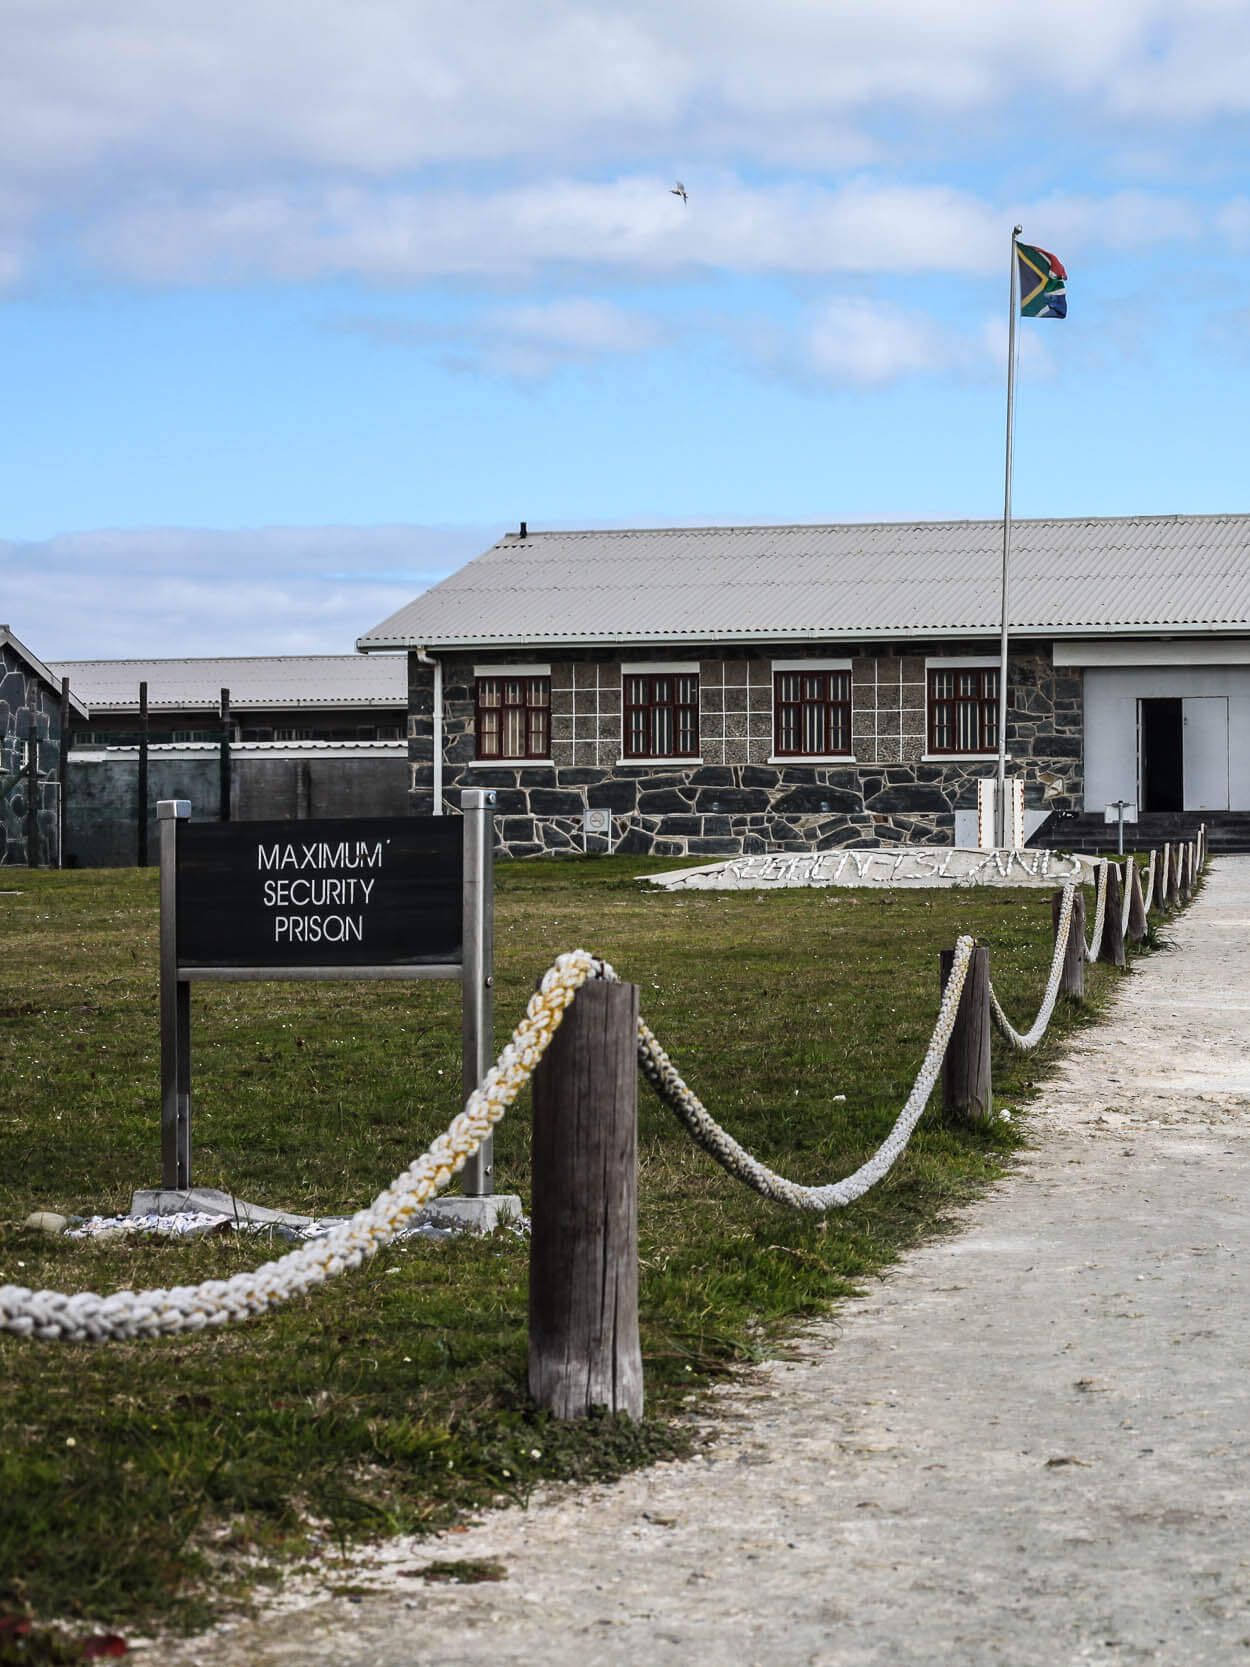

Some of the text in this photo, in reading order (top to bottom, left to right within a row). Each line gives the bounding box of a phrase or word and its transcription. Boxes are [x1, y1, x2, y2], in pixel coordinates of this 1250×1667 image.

[258, 842, 383, 870] MAXIMUM
[263, 878, 375, 906] SECURITY
[274, 915, 363, 942] PRISON
